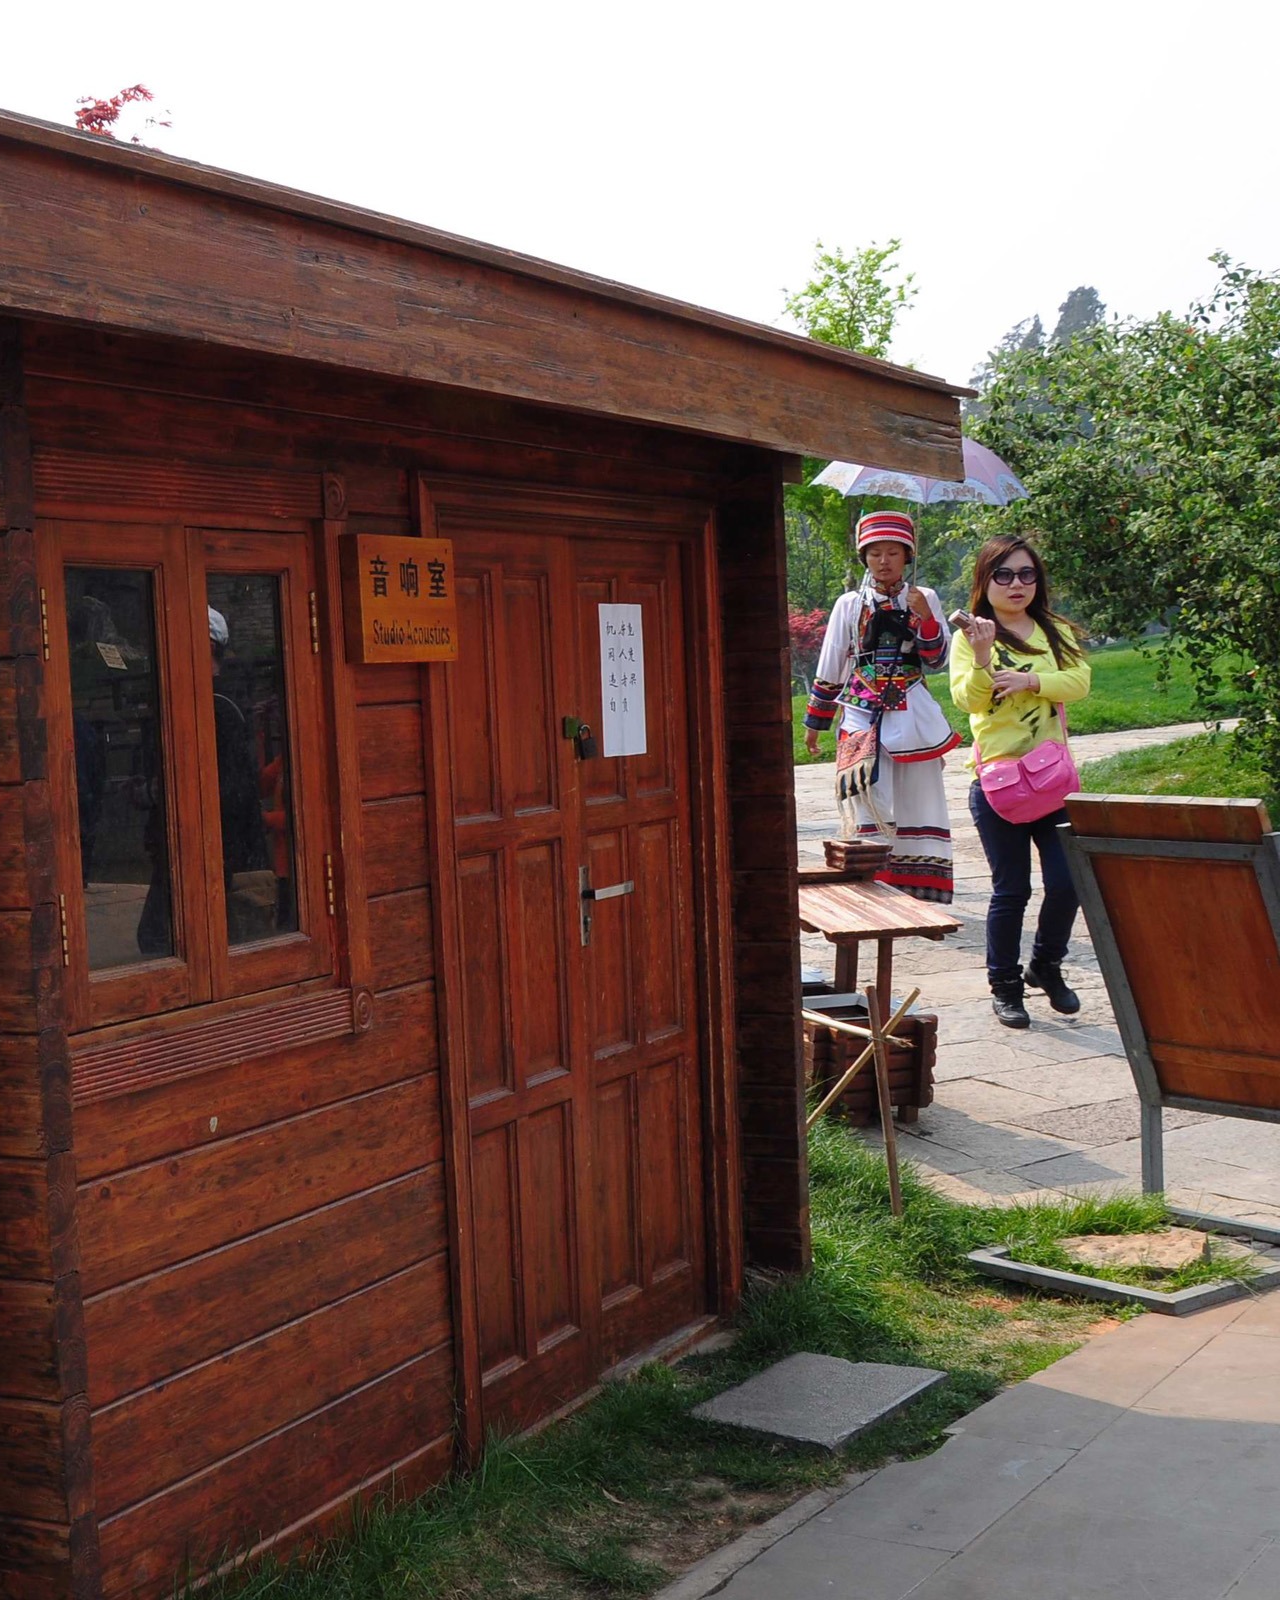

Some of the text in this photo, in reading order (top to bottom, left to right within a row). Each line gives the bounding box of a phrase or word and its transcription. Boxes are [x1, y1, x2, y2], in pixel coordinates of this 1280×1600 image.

[369, 555, 448, 598] 音响室
[373, 619, 451, 646] Studio Acoustics
